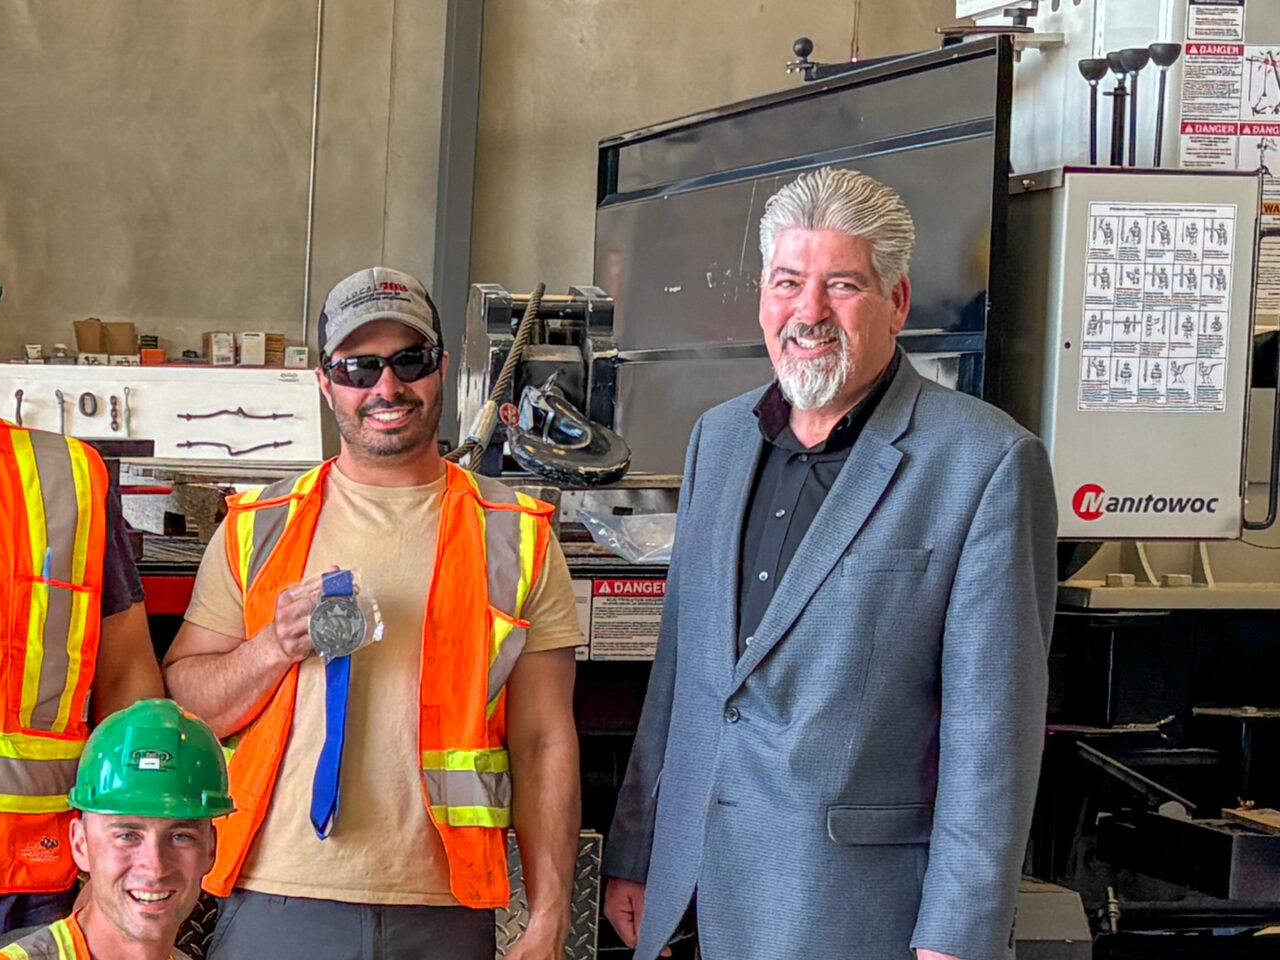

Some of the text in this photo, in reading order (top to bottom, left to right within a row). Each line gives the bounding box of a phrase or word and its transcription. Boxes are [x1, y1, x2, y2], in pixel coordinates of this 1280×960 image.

[1200, 45, 1239, 54] DANGER
[1195, 124, 1235, 134] DANGER
[1077, 489, 1219, 516] Manitowoc
